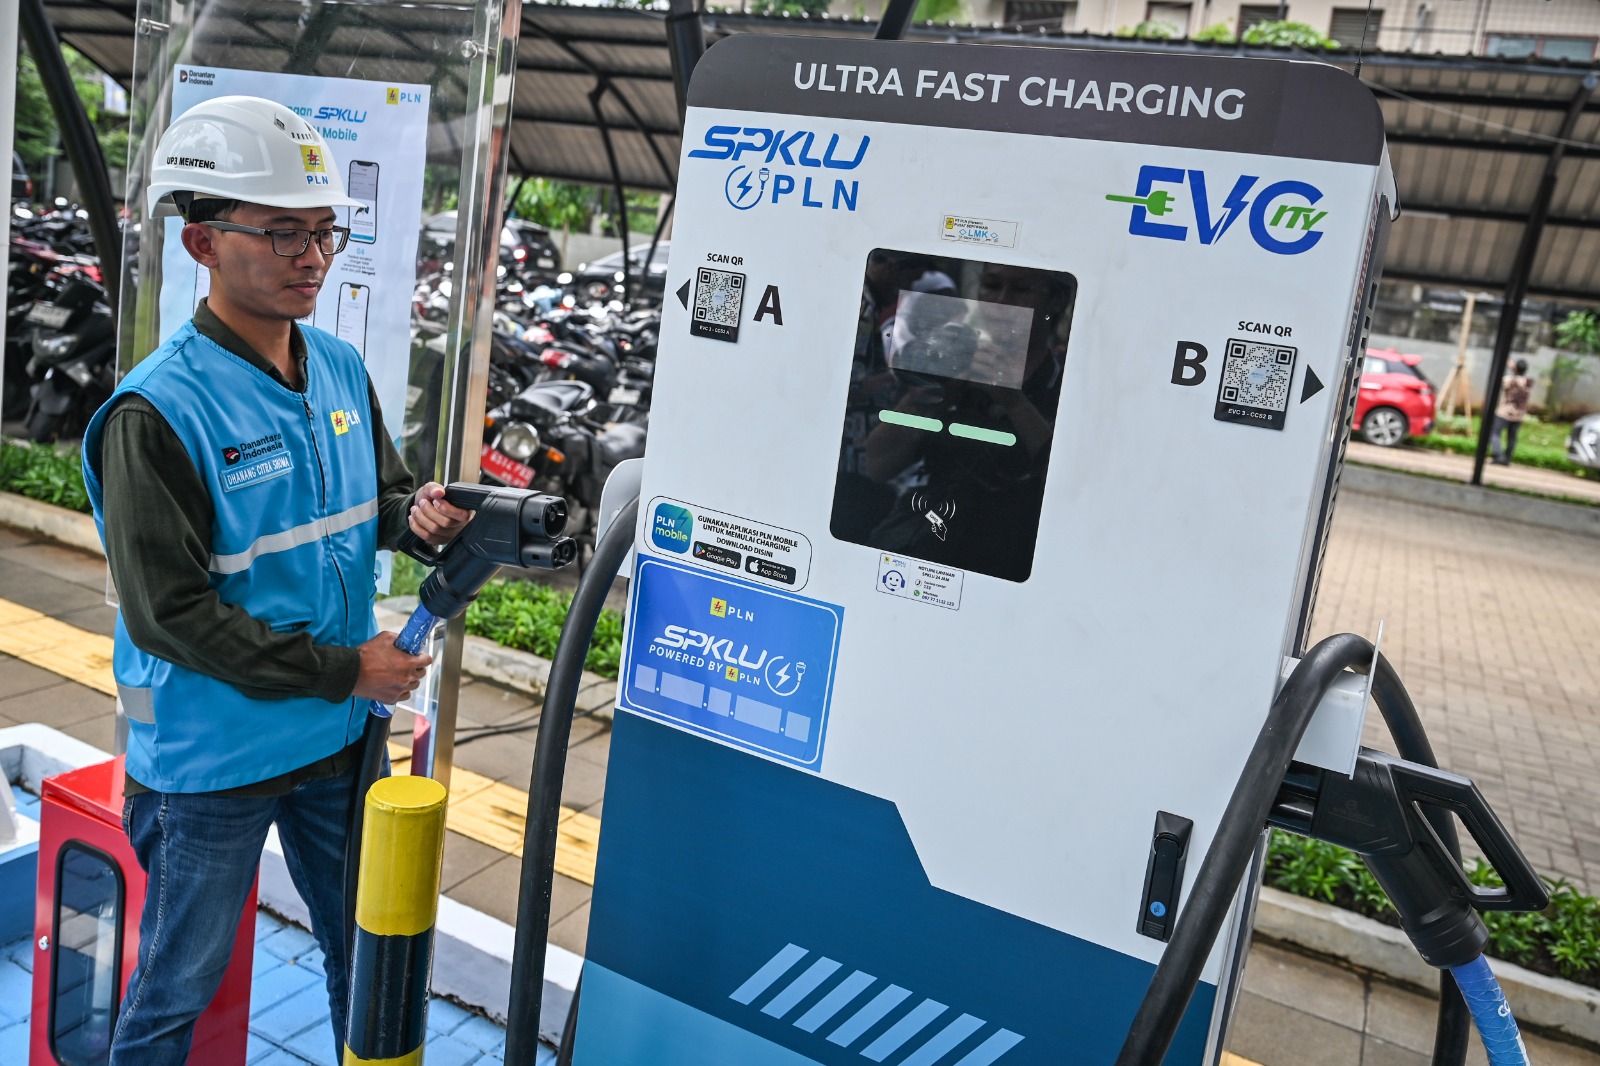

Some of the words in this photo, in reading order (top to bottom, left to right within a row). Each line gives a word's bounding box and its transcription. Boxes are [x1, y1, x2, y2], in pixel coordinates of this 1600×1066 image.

[188, 69, 215, 79] Danantara
[188, 77, 214, 86] Indonesia
[400, 92, 421, 103] PLN
[794, 62, 903, 96] ULTRA
[915, 69, 1010, 103] FAST
[1018, 76, 1246, 121] CHARGING
[314, 106, 367, 123] SPKLU
[322, 127, 358, 141] Mobile
[688, 125, 870, 170] SPKLU
[166, 156, 178, 165] UP3
[179, 157, 215, 170] MENTENG
[306, 175, 329, 184] PLN
[771, 174, 859, 211] PLN
[968, 229, 988, 239] LMK
[706, 252, 730, 264] SCAN
[731, 256, 744, 265] QR
[753, 284, 784, 326] A
[1237, 321, 1272, 334] SCAN
[1274, 325, 1292, 337] QR
[1170, 340, 1209, 386] B
[344, 409, 361, 427] PLN
[240, 433, 282, 452] Danantara
[242, 441, 283, 461] Indonesia
[227, 466, 257, 485] DHANANG
[656, 515, 675, 528] PLN
[655, 526, 688, 542] mobile
[697, 515, 729, 529] GUNAKAN
[730, 523, 759, 537] APLIKASI
[759, 531, 773, 541] PLN
[773, 535, 798, 548] MOBILE
[702, 523, 724, 535] UNTUK
[725, 530, 755, 543] MEMULAI
[756, 538, 791, 553] CHARGING
[716, 537, 753, 552] DOWNLOAD
[753, 548, 774, 558] DISINI
[706, 551, 725, 563] Google
[725, 557, 738, 567] Play
[760, 567, 772, 577] App
[772, 569, 788, 580] Store
[727, 605, 755, 622] PLN
[653, 624, 768, 670] SPKLU
[648, 644, 705, 668] POWERED
[707, 659, 724, 673] BY
[739, 672, 761, 686] PLN
